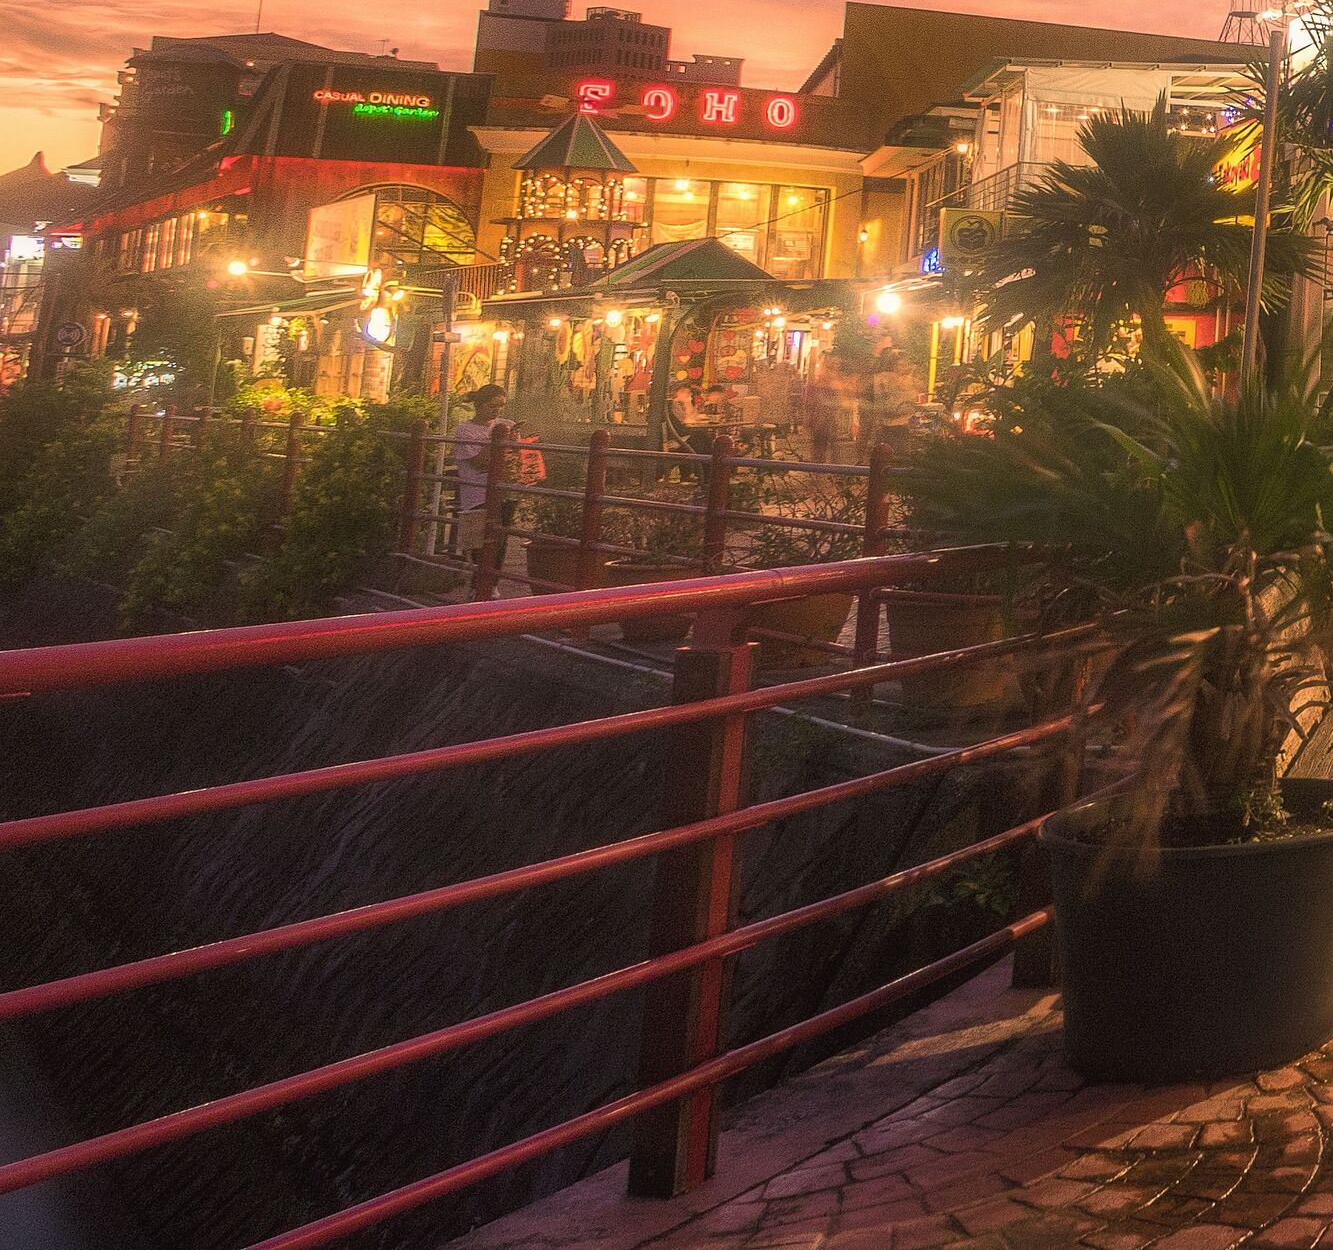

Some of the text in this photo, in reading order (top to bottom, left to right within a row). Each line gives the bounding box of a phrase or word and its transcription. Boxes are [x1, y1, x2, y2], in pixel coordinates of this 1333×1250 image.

[313, 90, 431, 108] CASUAL DINING
[578, 83, 796, 128] SOHO
